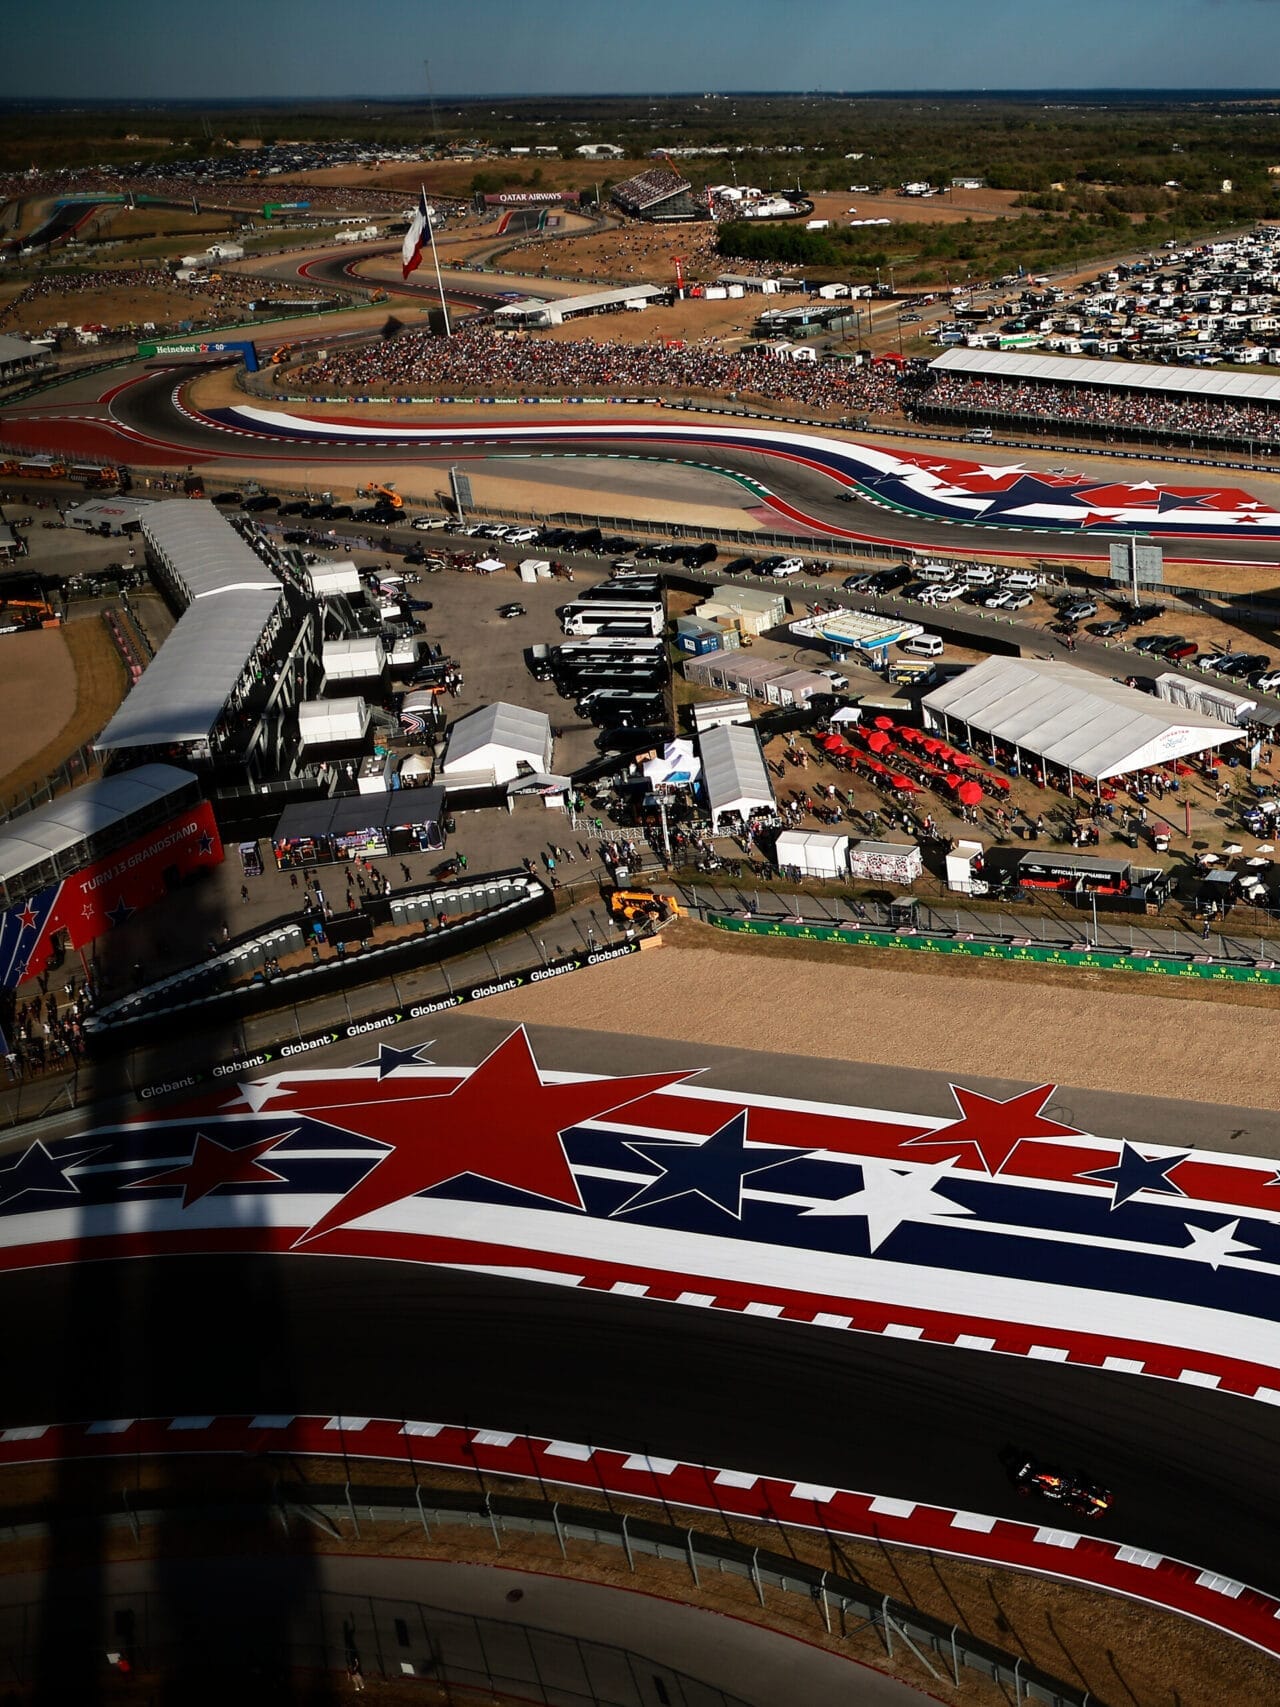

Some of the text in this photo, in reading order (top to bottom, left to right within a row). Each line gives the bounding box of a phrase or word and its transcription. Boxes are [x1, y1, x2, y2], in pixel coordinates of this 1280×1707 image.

[500, 193, 562, 202] QATAR AIRWAYS
[156, 345, 196, 354] Heineken
[80, 822, 198, 894] TURN 13 GRANDSTAND
[588, 945, 630, 965] Globant
[530, 962, 574, 982] Globant
[472, 979, 516, 1000] Globant
[410, 997, 457, 1018] Globant
[347, 1014, 395, 1037] Globant
[281, 1035, 331, 1057] Globant
[213, 1054, 264, 1077] Globant
[141, 1076, 195, 1099] Globant
